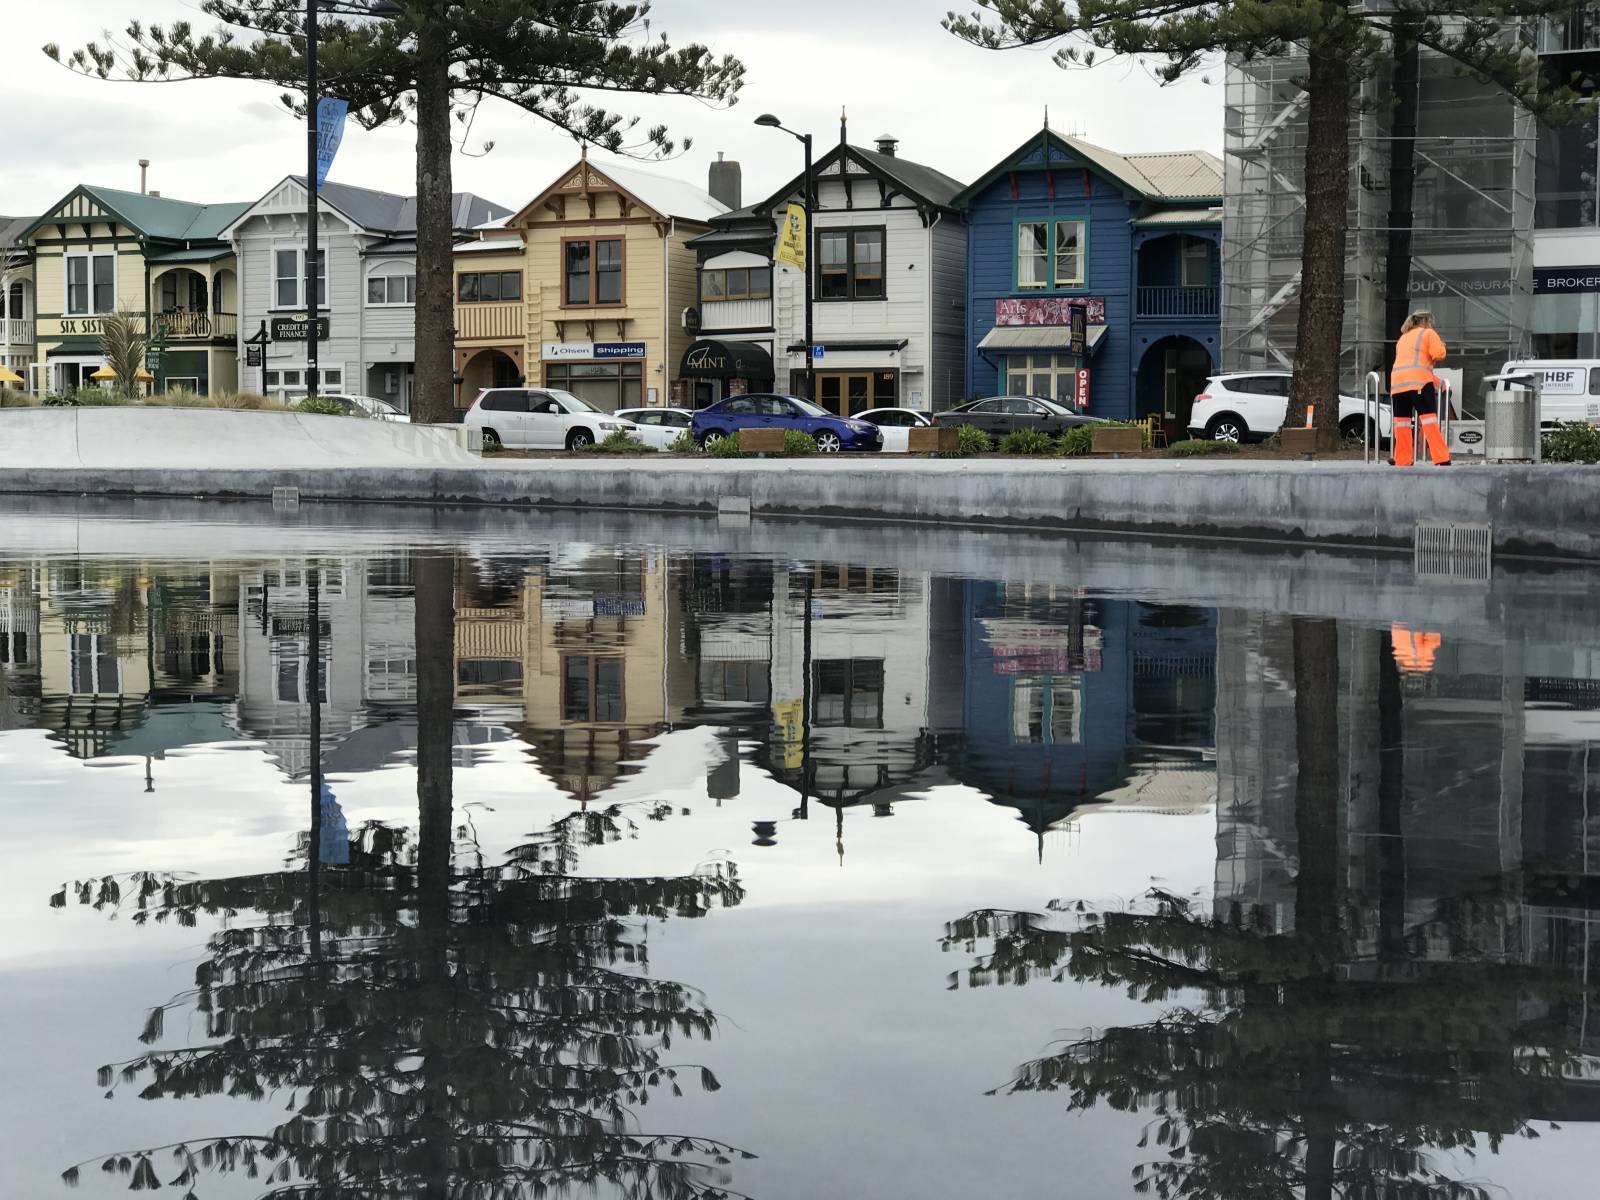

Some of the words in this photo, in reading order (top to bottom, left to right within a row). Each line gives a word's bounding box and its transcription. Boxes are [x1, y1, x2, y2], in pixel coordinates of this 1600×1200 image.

[61, 320, 76, 333] SIX
[277, 323, 300, 331] CREDIT
[279, 330, 308, 338] FINANCE
[560, 347, 590, 355] Olsen
[597, 346, 644, 354] Shipping
[691, 356, 726, 369] MINT
[1545, 371, 1575, 382] HBF
[1078, 370, 1087, 405] OPEN
